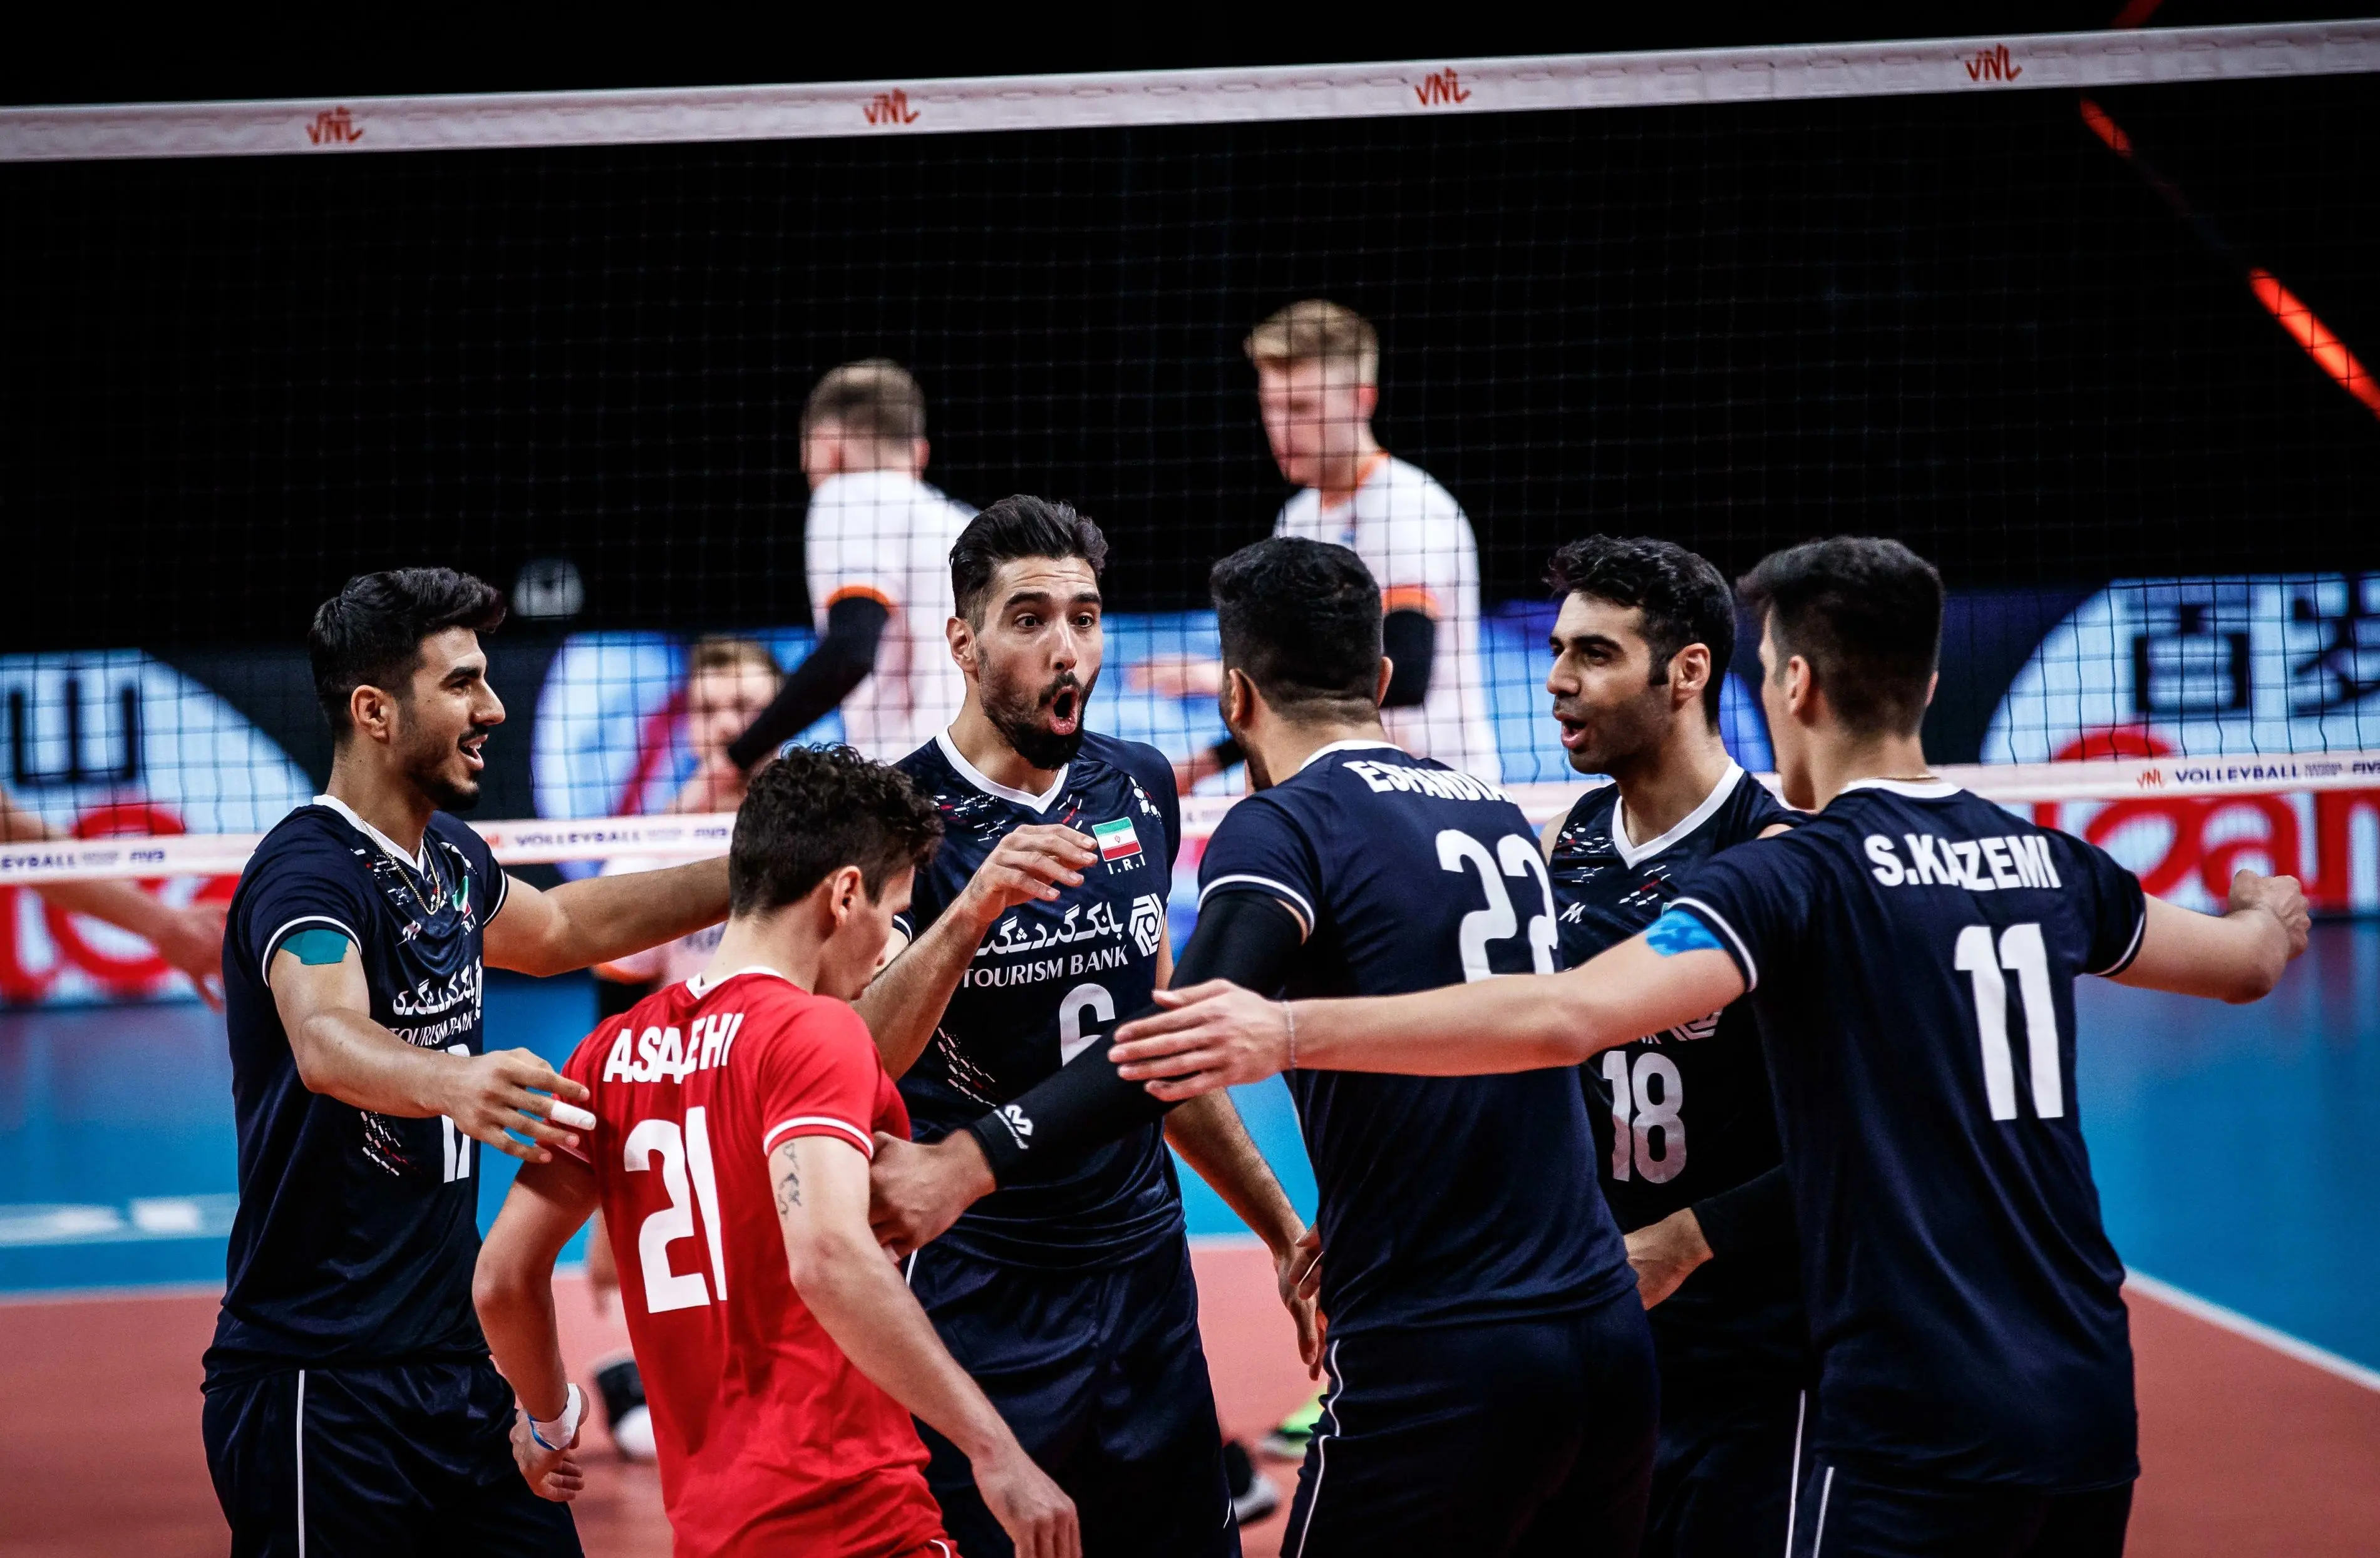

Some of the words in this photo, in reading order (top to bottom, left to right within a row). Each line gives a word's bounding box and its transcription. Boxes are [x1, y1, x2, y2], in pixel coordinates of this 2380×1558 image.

[1964, 43, 2022, 81] VNL
[1414, 67, 1471, 106] VNL
[2175, 764, 2299, 784] VOLLEYBALL
[1107, 854, 1146, 874] I.R.I
[1864, 833, 2061, 891] S.KAZEMI
[962, 957, 1064, 988] TOURISM
[1069, 945, 1128, 976] BANK
[1954, 922, 2064, 1122] 11
[1602, 1050, 1687, 1184] 18
[624, 1105, 728, 1314] 21
